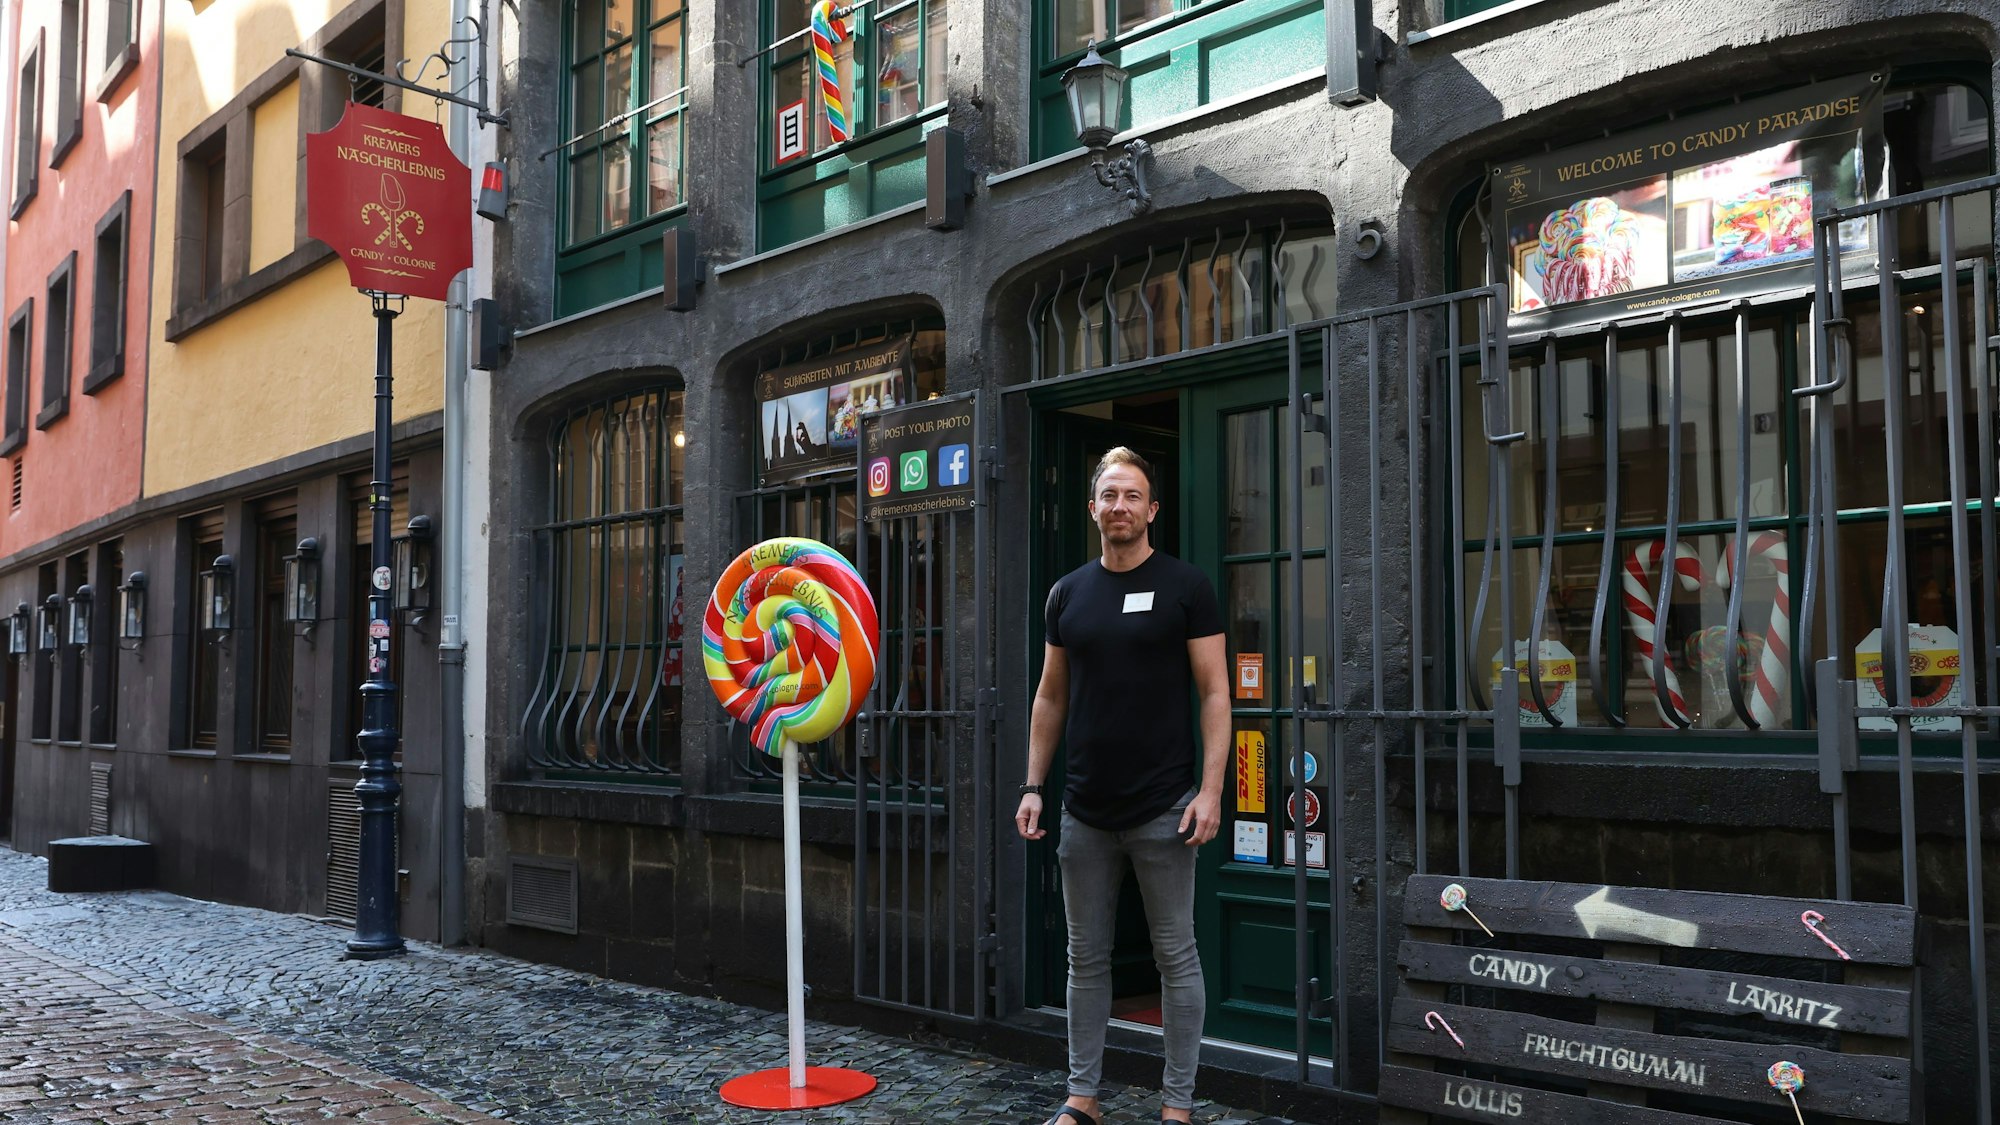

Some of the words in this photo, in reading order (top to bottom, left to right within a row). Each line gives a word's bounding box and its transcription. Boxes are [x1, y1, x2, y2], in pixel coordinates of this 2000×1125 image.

[363, 134, 421, 157] KREMERS
[1557, 148, 1643, 182] WELCOME
[1649, 141, 1676, 160] TO
[1682, 121, 1751, 152] CANDY
[1758, 96, 1860, 135] PARADISE
[337, 146, 446, 181] NASCHERLEBNIS
[1354, 220, 1381, 260] 5
[350, 248, 385, 261] CANDY
[393, 255, 436, 270] COLOGNE
[1626, 287, 1720, 310] www.candy-cologne.com
[835, 362, 852, 377] MIT
[854, 350, 898, 372] AMBIENTE
[884, 425, 906, 440] POST
[908, 420, 934, 434] YOUR
[936, 414, 970, 431] PHOTO
[870, 496, 966, 519] @kremersnascherlebnis
[1238, 742, 1249, 800] DHL
[1256, 740, 1265, 803] PAKETSHOP
[1288, 833, 1318, 842] ACUNG
[1469, 953, 1556, 989] CANDY
[1726, 981, 1843, 1028] LAKRITZ
[1523, 1032, 1706, 1086] FRUCHTGUMMI
[1443, 1081, 1522, 1117] LOLLIS
